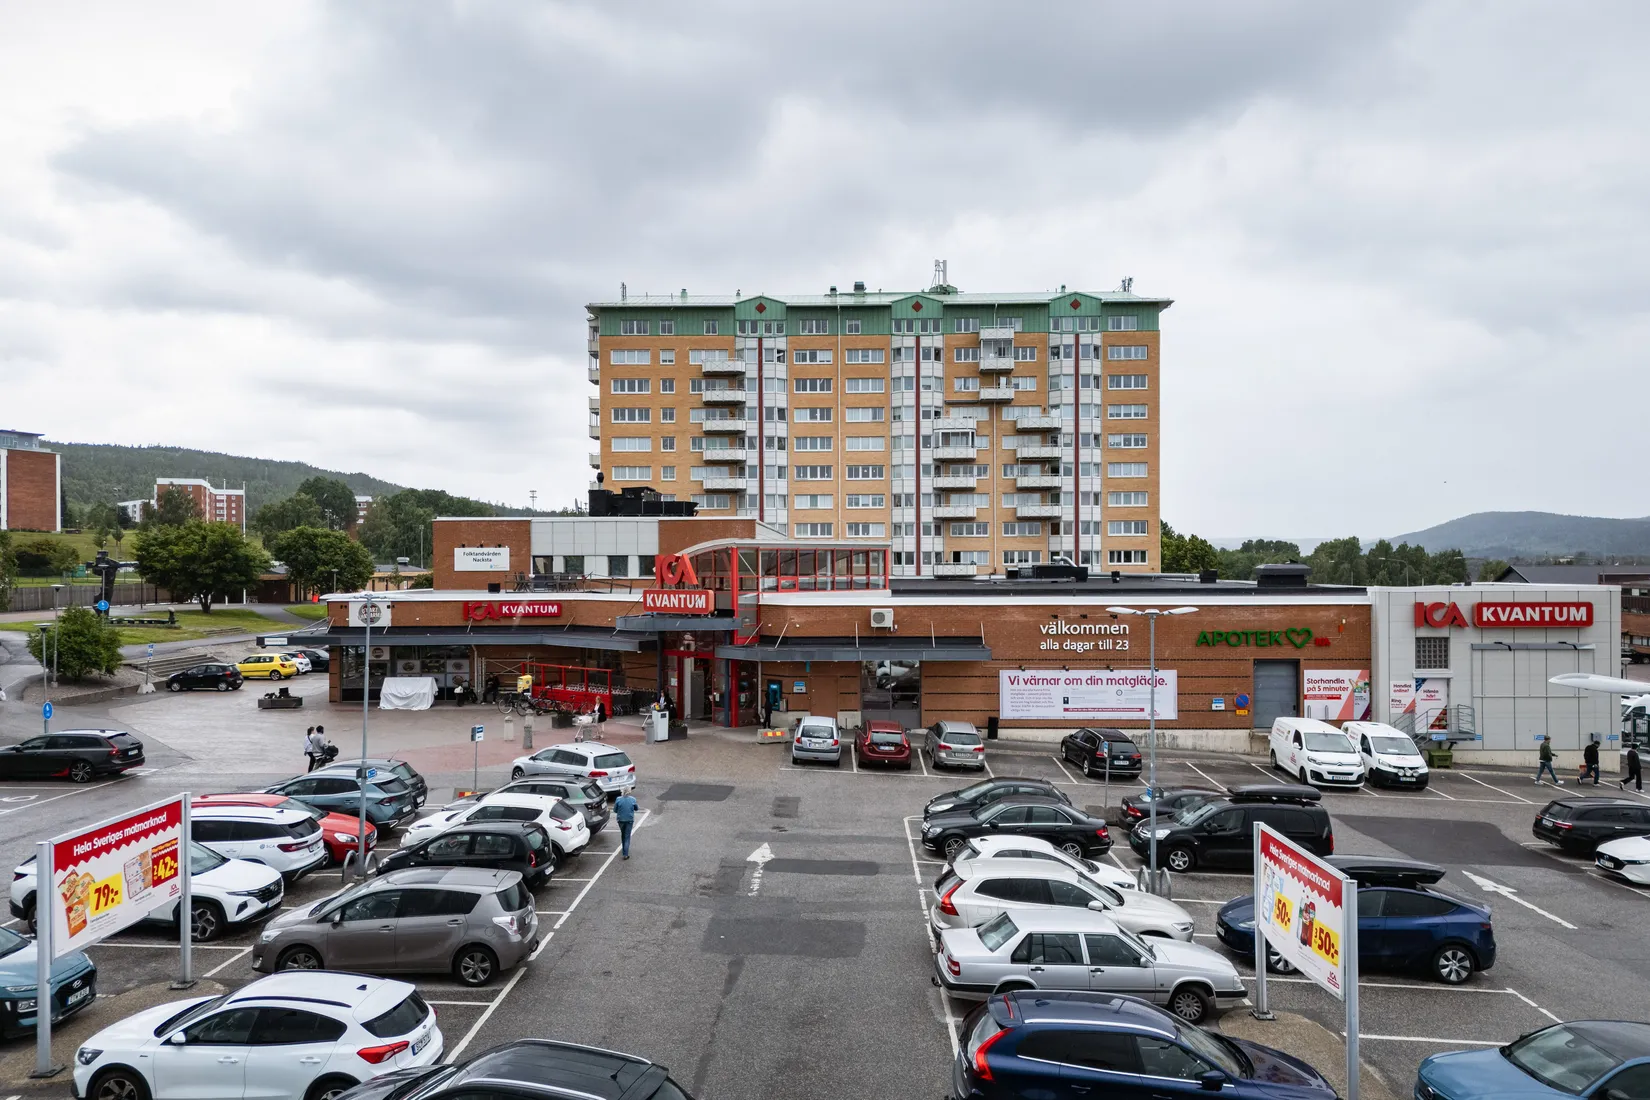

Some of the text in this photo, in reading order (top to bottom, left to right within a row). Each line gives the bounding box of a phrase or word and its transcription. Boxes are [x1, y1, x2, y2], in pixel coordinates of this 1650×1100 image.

[655, 553, 699, 585] ICA
[463, 601, 558, 621] ICA KVANTUM
[646, 593, 706, 609] KVANTUM
[1414, 601, 1587, 629] ICA KVANTUM
[1040, 620, 1129, 635] välkommen
[1040, 639, 1129, 653] alla dagar till 23
[1196, 630, 1284, 647] APOTEK
[1008, 675, 1020, 686] Vi
[1022, 675, 1061, 686] värnar
[1064, 678, 1083, 686] om
[1085, 675, 1104, 686] din
[1306, 677, 1346, 685] Storhandla
[1306, 685, 1317, 693] på
[73, 812, 167, 857] Hela Sveriges matmarknad
[1269, 842, 1331, 892] Hela Sveriges matmarknad
[94, 883, 119, 911] 79:-
[1276, 897, 1291, 927] 50:-
[1317, 926, 1339, 960] 50:-
